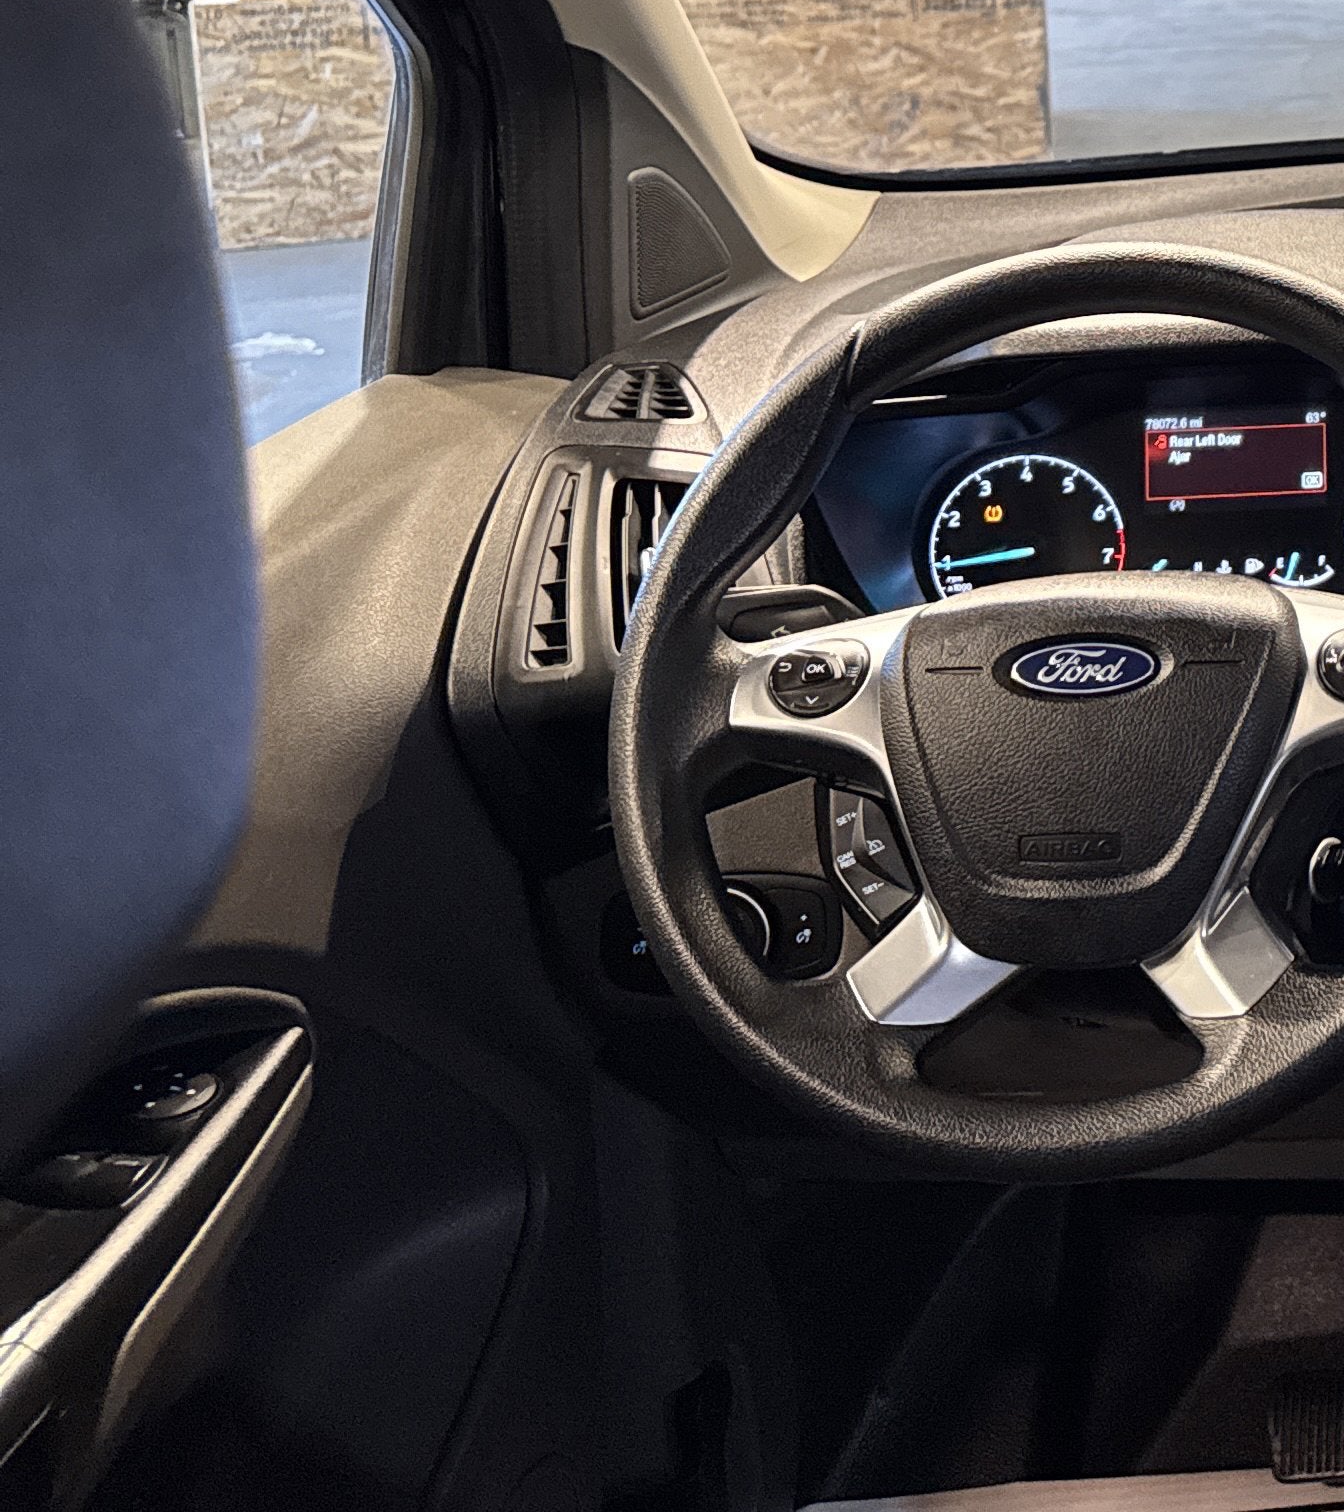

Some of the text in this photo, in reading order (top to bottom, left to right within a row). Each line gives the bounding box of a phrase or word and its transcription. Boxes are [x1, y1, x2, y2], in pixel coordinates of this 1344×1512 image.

[1144, 416, 1204, 431] 78072.6 mi
[1305, 410, 1327, 424] 63°
[1168, 432, 1243, 449] Rear Left Door
[1167, 450, 1192, 466] Ajar
[1019, 465, 1034, 483] 4
[1304, 473, 1322, 486] OK
[978, 479, 992, 498] 3
[1061, 476, 1076, 494] 5
[947, 510, 961, 528] 2
[1092, 504, 1107, 522] 6
[1101, 547, 1115, 565] 7
[805, 662, 827, 674] OK
[1036, 648, 1127, 684] Ford
[835, 811, 857, 827] SET+
